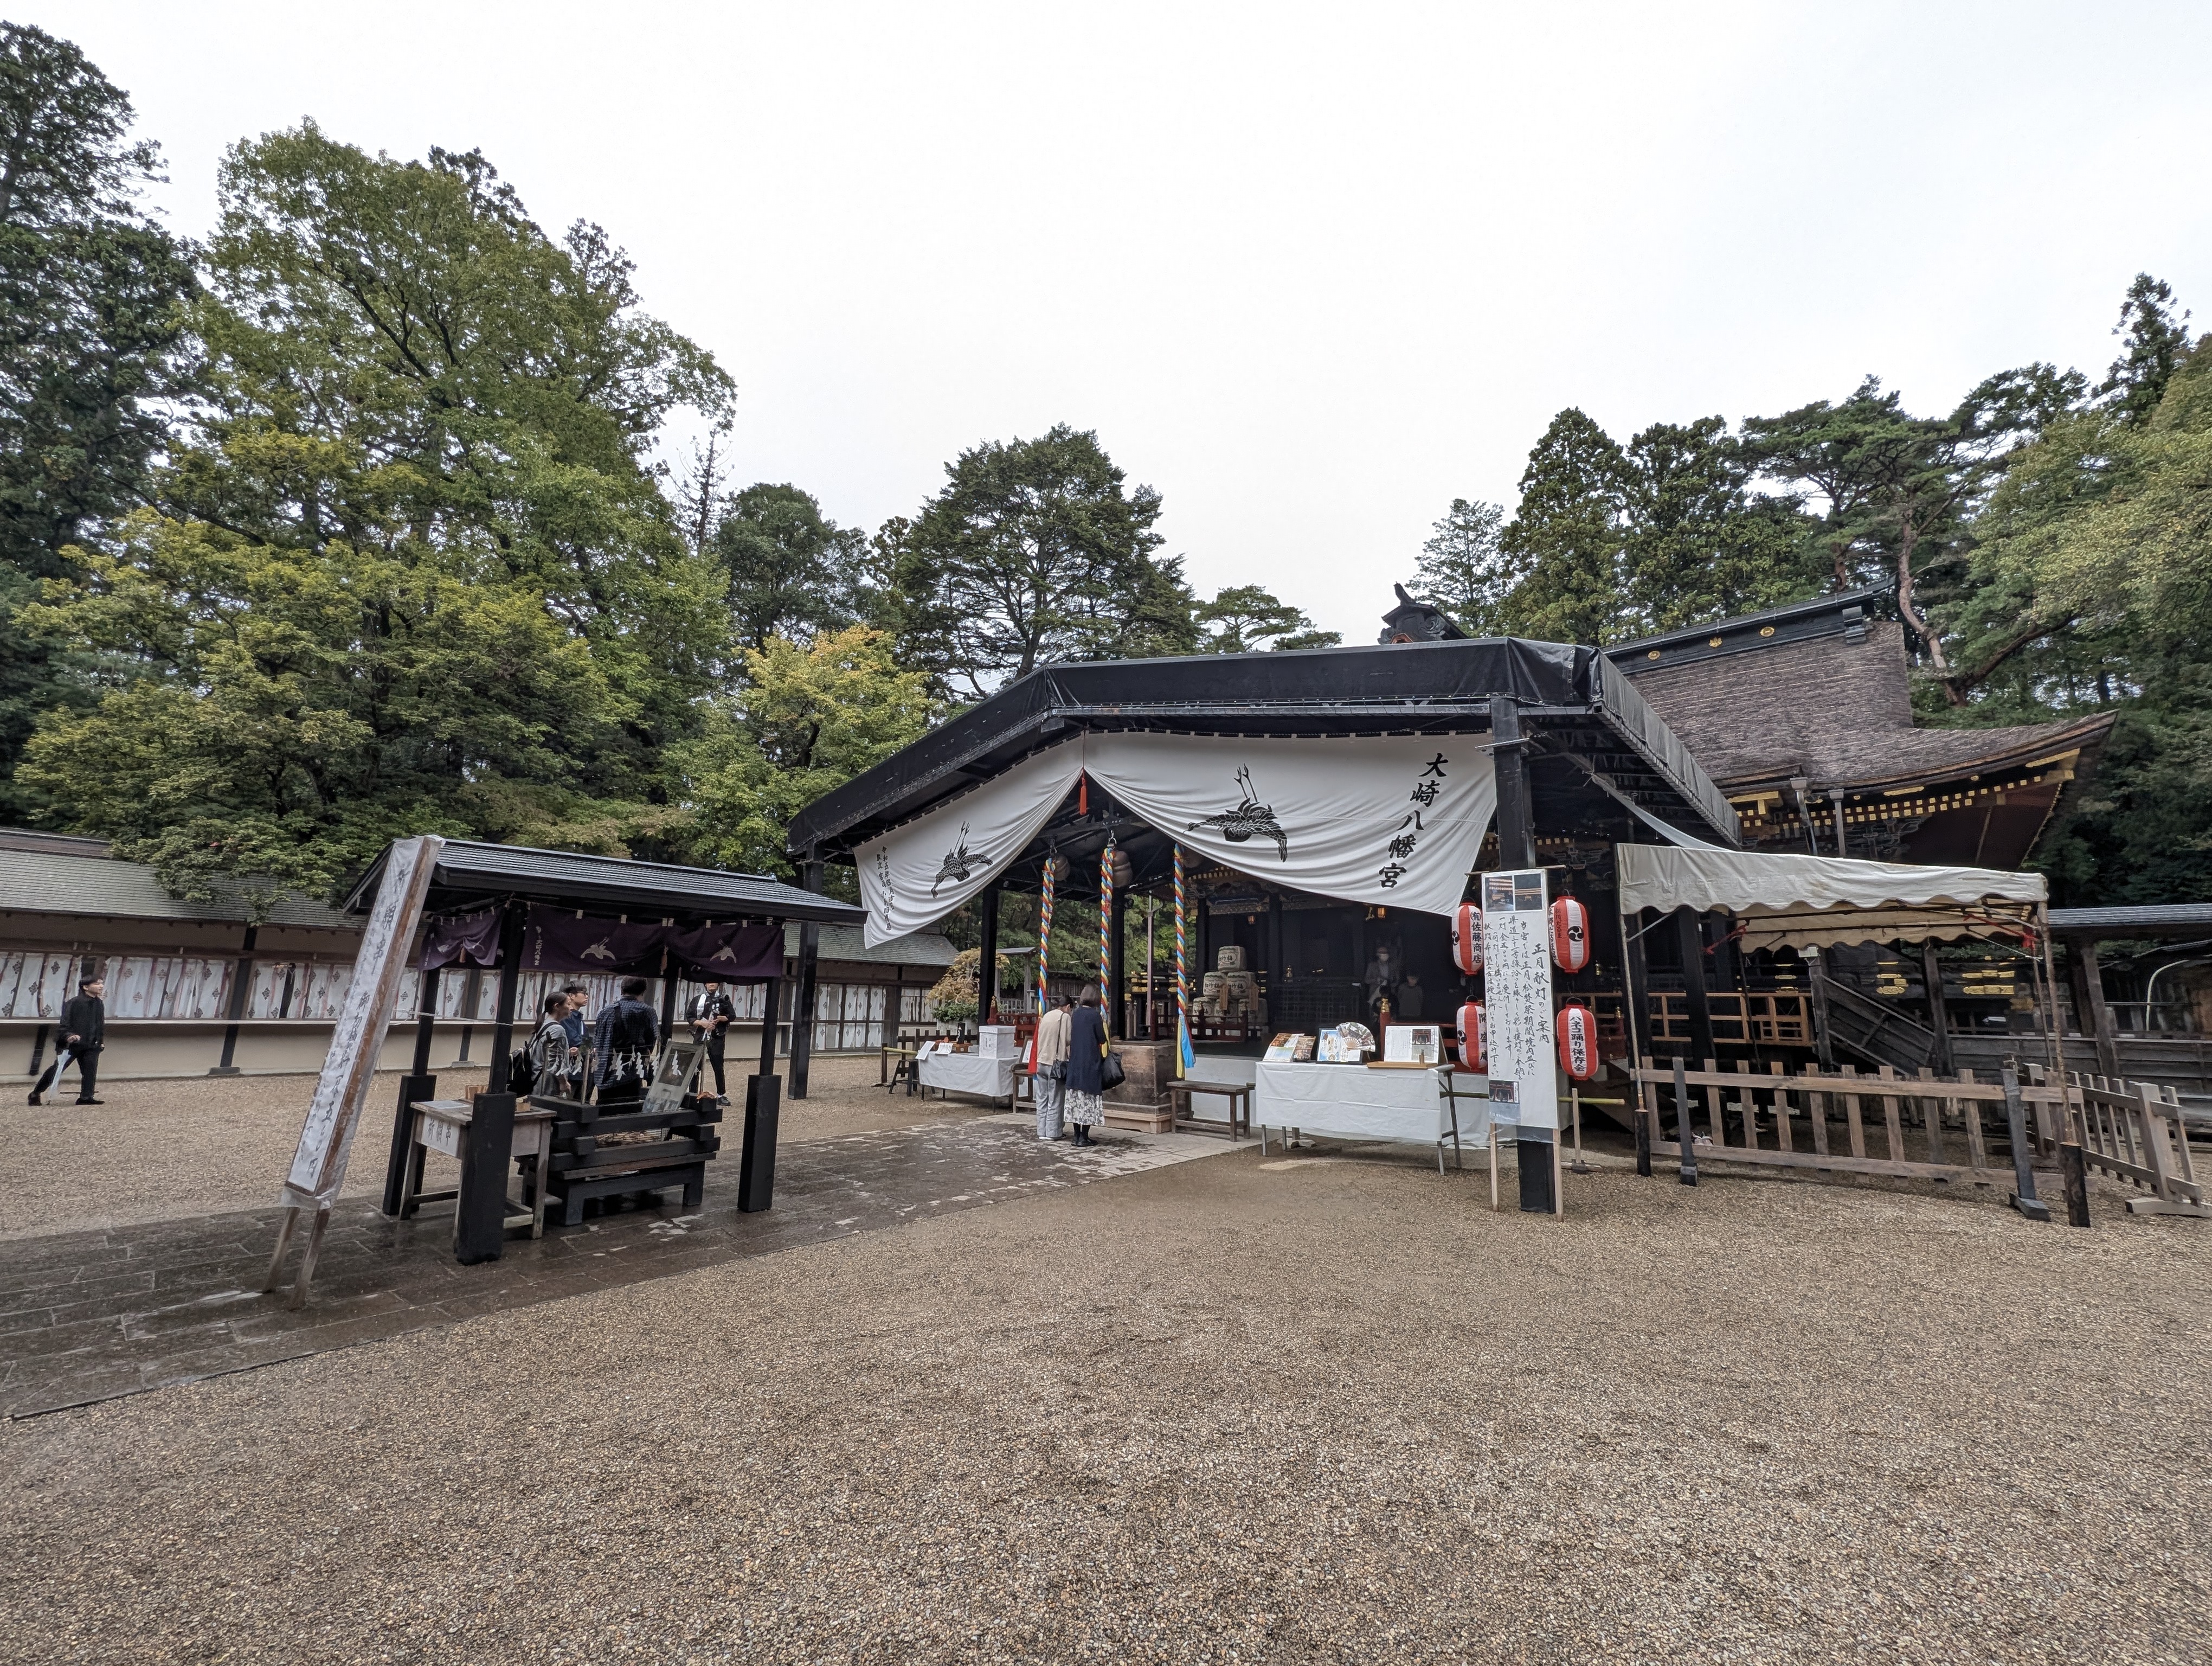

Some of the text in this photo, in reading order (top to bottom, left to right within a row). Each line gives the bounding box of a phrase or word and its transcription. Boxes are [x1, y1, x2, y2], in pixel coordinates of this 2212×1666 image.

[1379, 753, 1449, 888] 大崎八幡宮
[1532, 943, 1551, 1044] 正月献灯のご案内
[1570, 1016, 1586, 1072] ハネコ踊り保存会
